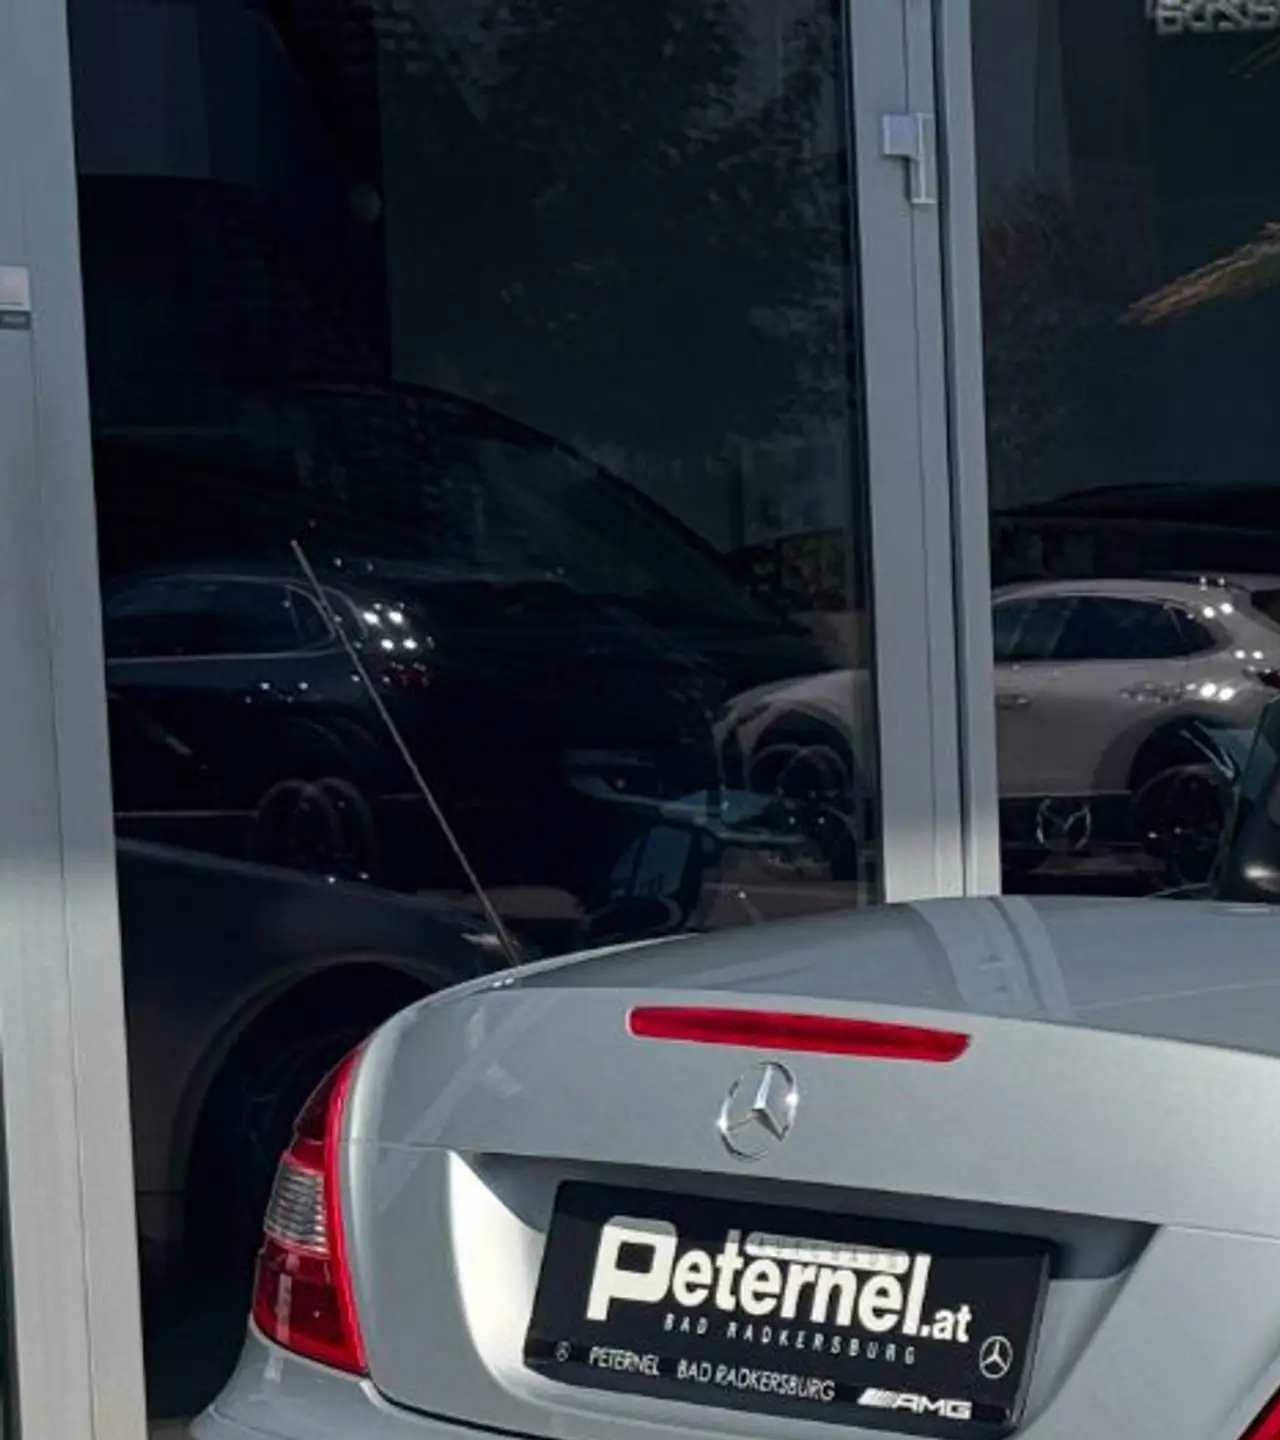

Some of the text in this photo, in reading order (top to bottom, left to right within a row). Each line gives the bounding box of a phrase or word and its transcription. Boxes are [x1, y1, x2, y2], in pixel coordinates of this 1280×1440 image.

[586, 1215, 972, 1343] Peternel.at
[664, 1312, 916, 1366] BAD RADKERSBURG
[589, 1346, 837, 1402] PETERNEL BAD RADKERSBURG
[890, 1391, 973, 1420] AMG
